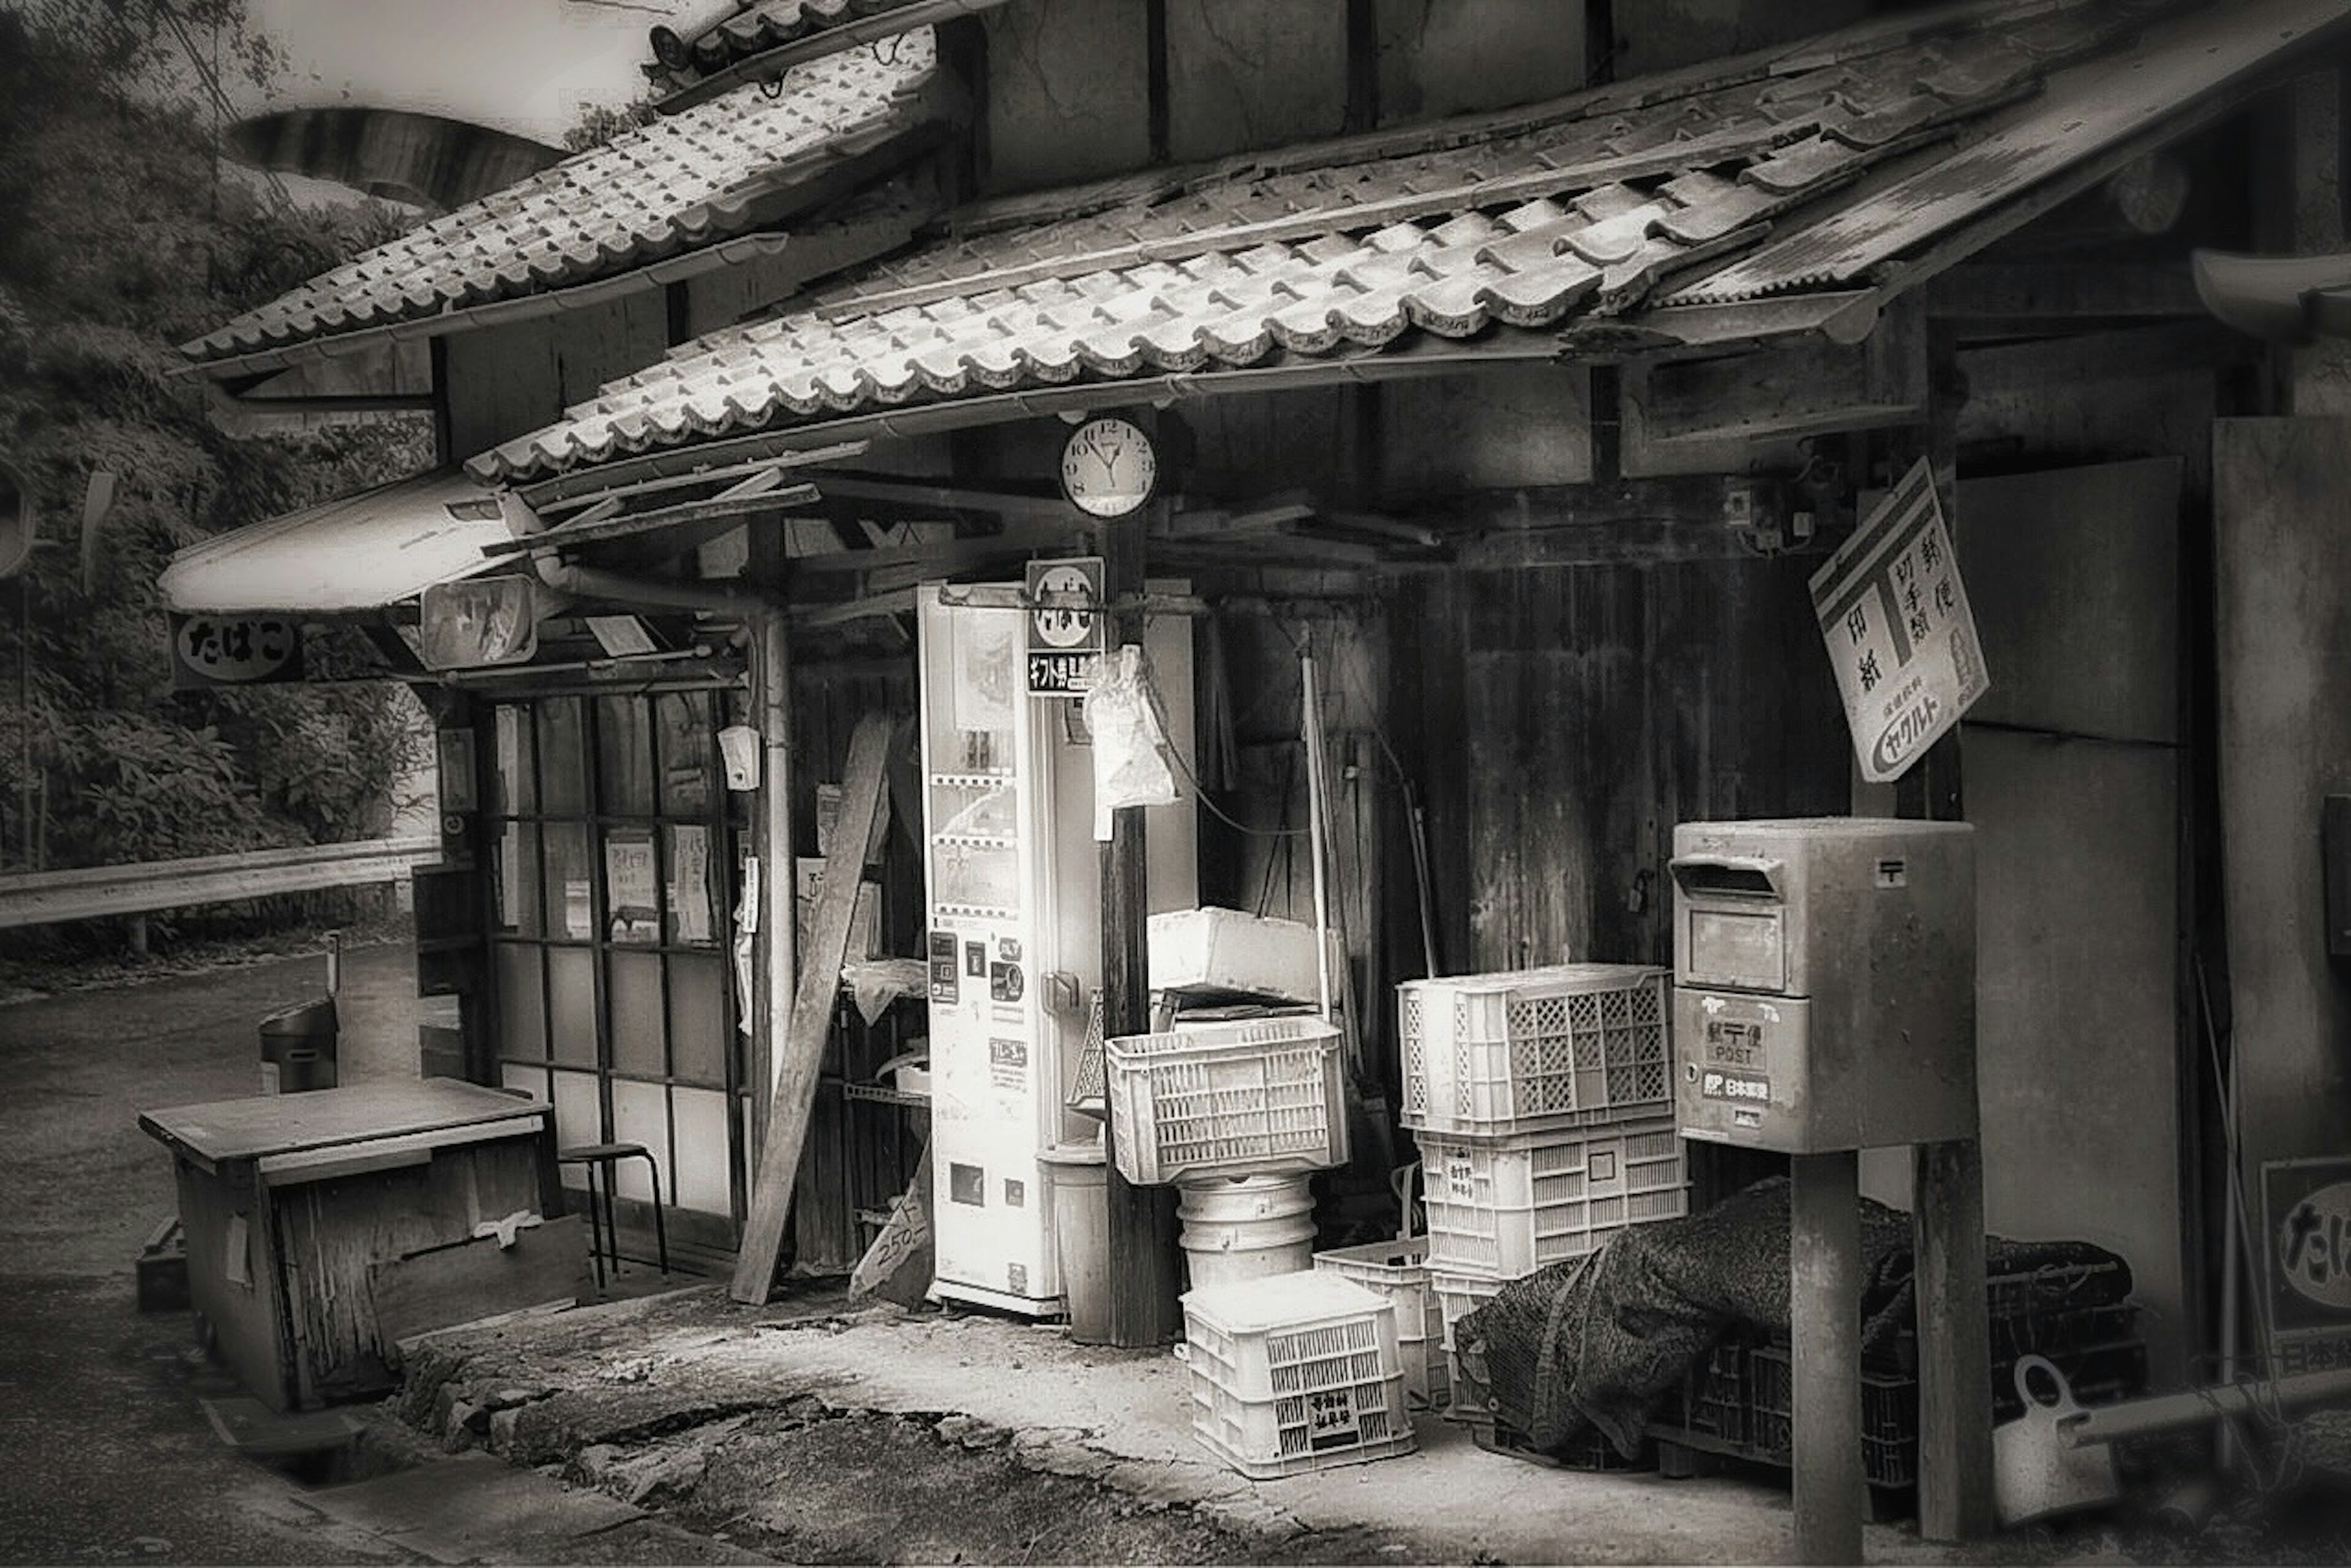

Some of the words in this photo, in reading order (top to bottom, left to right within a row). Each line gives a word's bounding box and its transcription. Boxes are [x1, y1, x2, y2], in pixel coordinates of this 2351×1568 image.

[1101, 421, 1118, 434] 12
[1071, 444, 1089, 457] 10
[1922, 529, 1954, 617] 郵便
[189, 621, 282, 664] たばこ
[1847, 603, 1883, 691] 印紙
[1885, 696, 1937, 759] ヤクルト
[1716, 1046, 1751, 1065] POST
